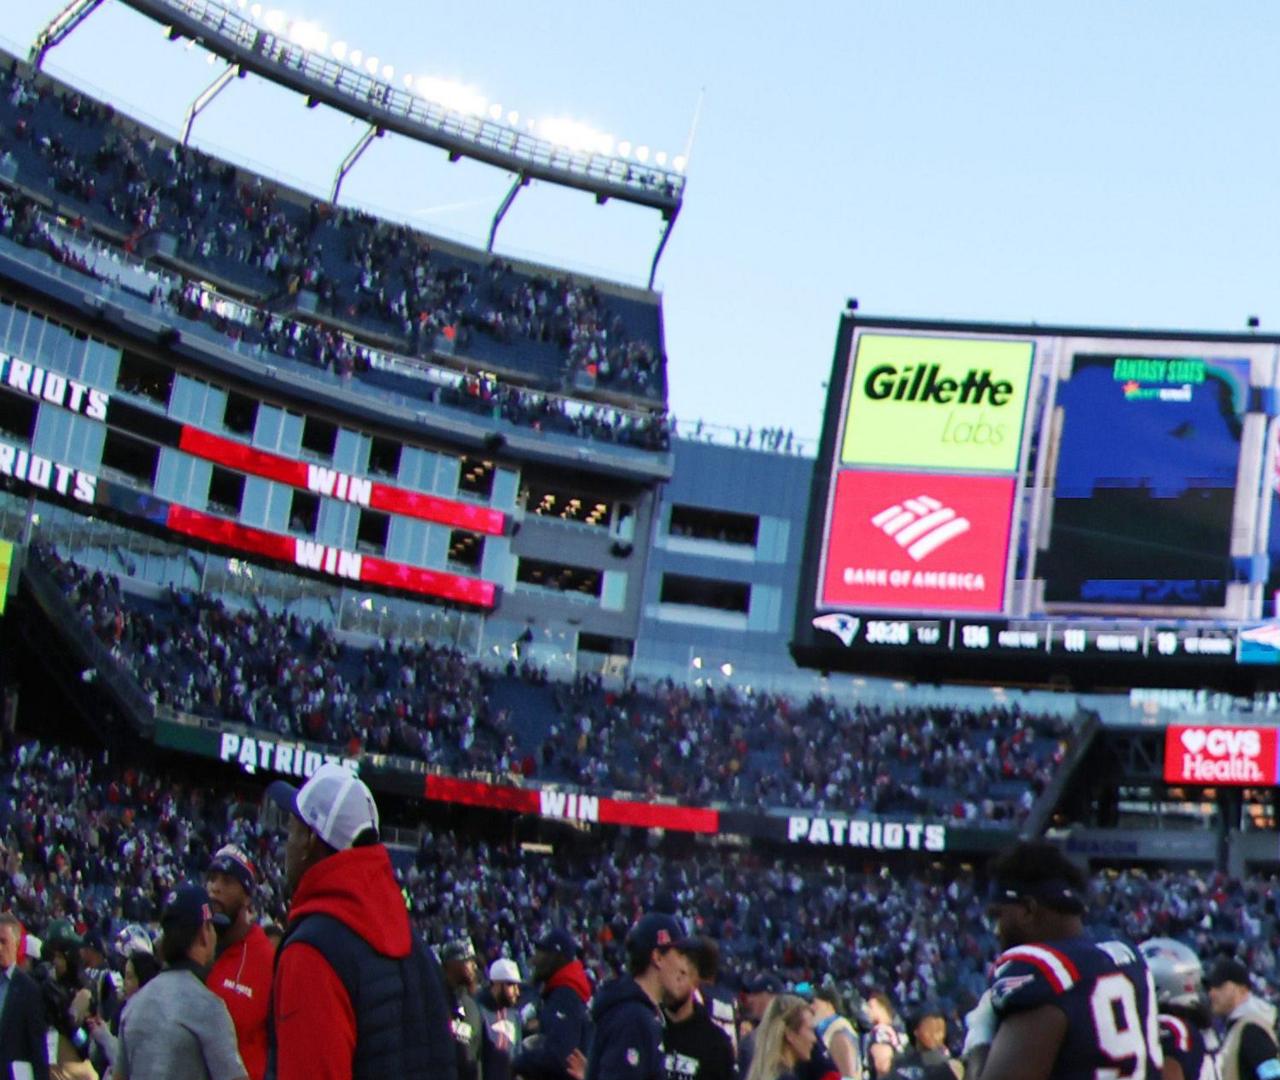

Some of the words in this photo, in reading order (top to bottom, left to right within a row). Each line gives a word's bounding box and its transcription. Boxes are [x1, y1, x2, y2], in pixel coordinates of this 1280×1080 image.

[864, 363, 1014, 407] Gillette
[1113, 359, 1168, 382] FANTASY
[1167, 360, 1204, 383] STATS
[941, 411, 1006, 445] Labs
[307, 463, 372, 508] WIN
[295, 538, 362, 580] WIN
[844, 568, 887, 586] BANK
[889, 570, 910, 587] OF
[913, 571, 985, 591] AMERICA
[1207, 730, 1260, 757] CVS
[540, 790, 598, 821] WIN
[788, 816, 946, 851] PATRIOTS
